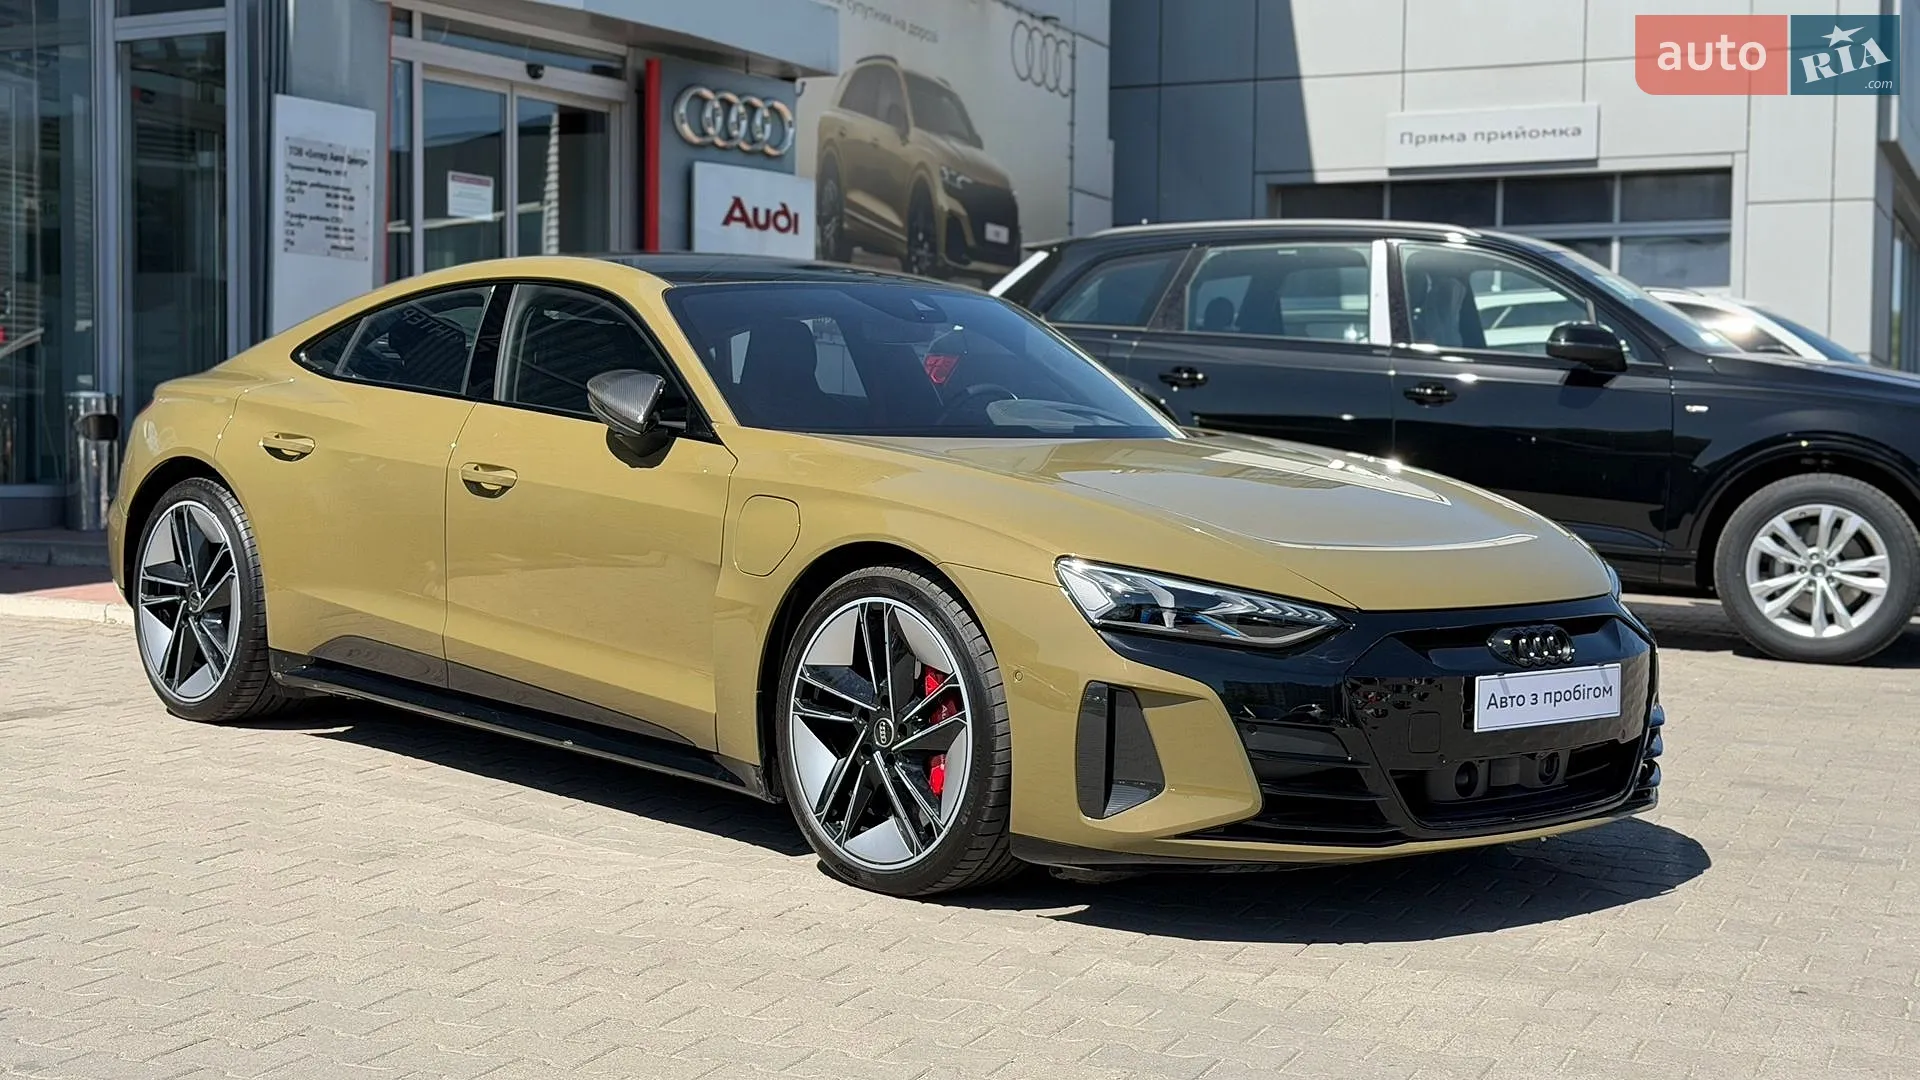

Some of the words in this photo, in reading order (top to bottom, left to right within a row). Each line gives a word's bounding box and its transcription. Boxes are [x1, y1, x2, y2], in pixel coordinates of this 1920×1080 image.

[1399, 131, 1467, 147] Пряма
[1473, 125, 1582, 144] прийомка
[721, 195, 799, 235] Audi
[1486, 692, 1526, 710] Авто
[1530, 692, 1538, 706] з
[1543, 683, 1613, 707] пробігом
